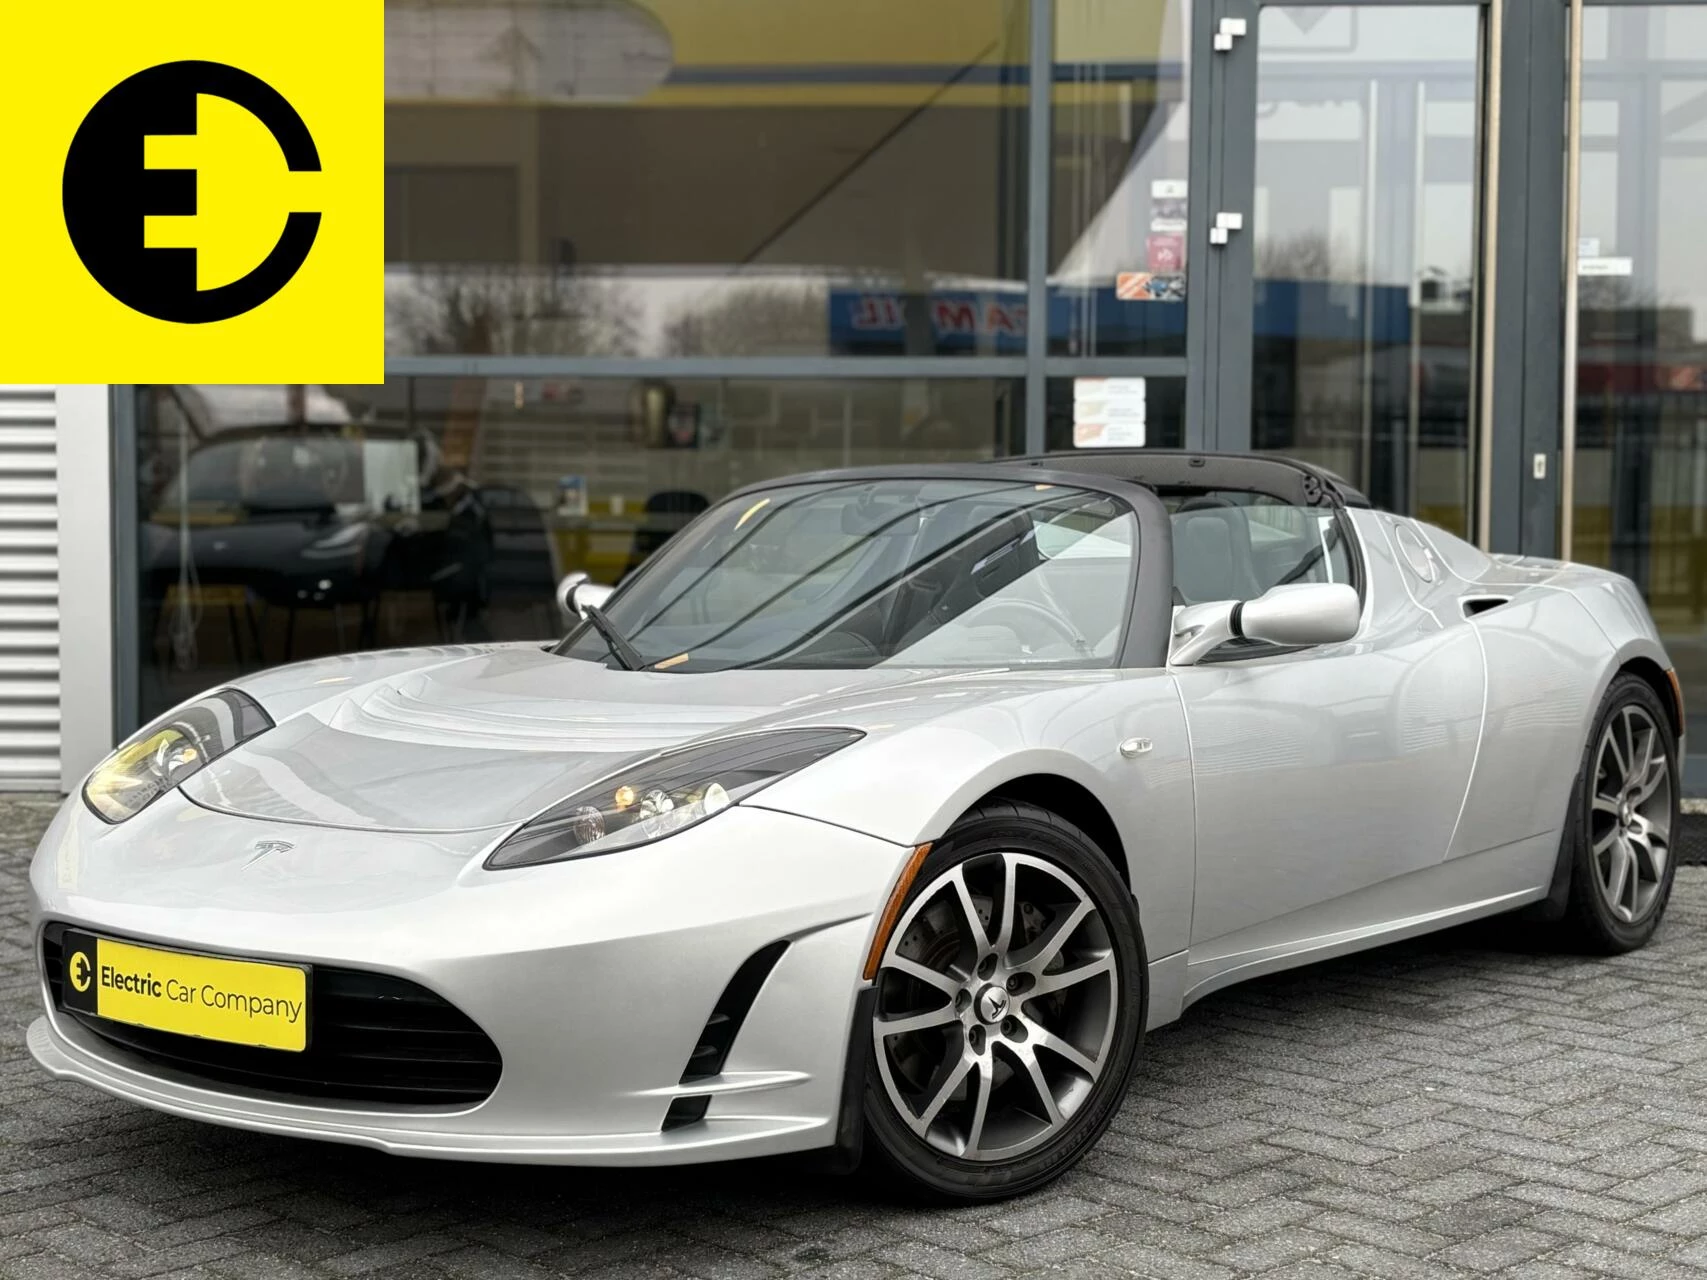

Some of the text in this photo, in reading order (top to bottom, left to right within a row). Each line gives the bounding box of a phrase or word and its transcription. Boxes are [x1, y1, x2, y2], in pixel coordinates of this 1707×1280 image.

[101, 965, 302, 1024] Electric Car Company
